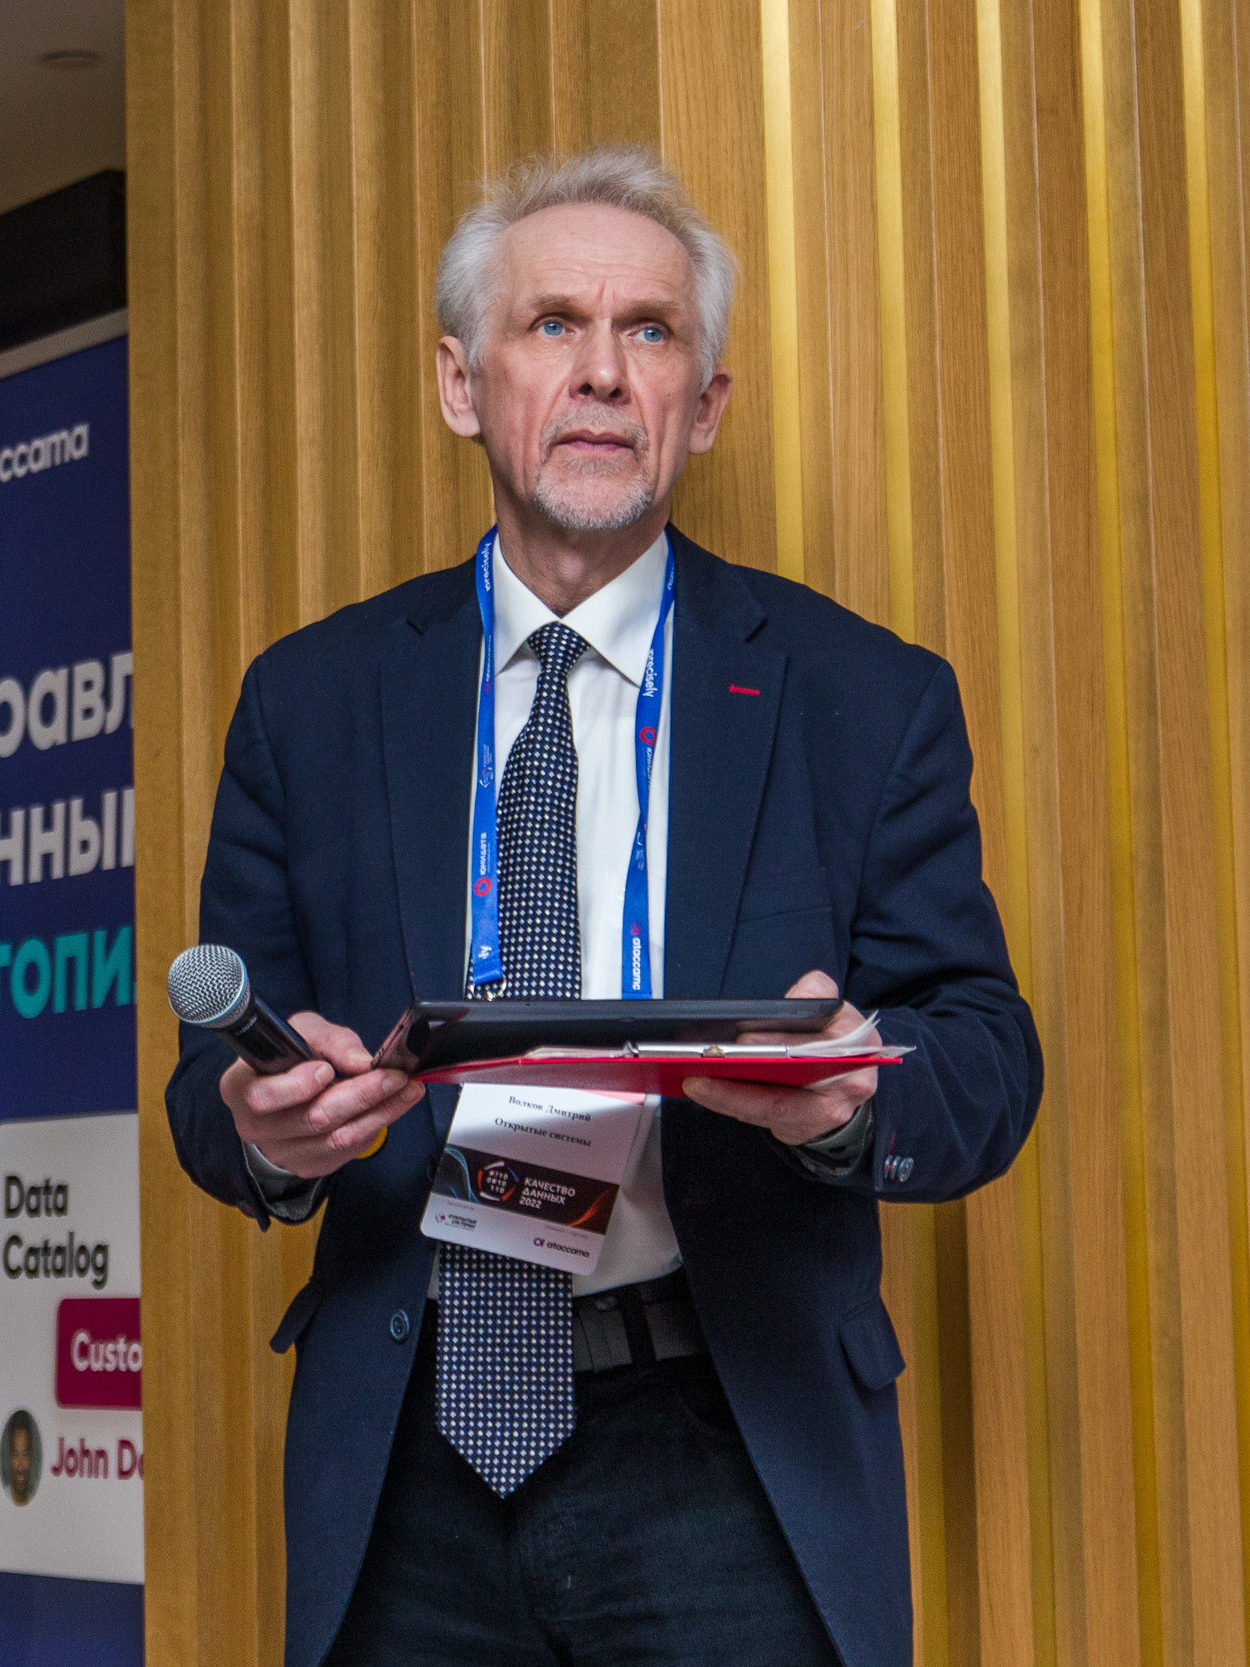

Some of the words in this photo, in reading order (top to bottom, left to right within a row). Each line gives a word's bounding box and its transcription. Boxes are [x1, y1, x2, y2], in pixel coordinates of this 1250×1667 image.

[546, 1104, 591, 1122] Дмитрий
[495, 1117, 548, 1137] Открытые
[549, 1132, 592, 1147] системы
[5, 1175, 68, 1219] Data
[522, 1187, 566, 1205] ДАННЫХ
[524, 1177, 576, 1197] КАЧЕСТВО
[519, 1196, 542, 1209] 2022
[546, 1241, 590, 1258] ataccama
[2, 1231, 109, 1290] Catalog
[51, 1437, 108, 1479] John
